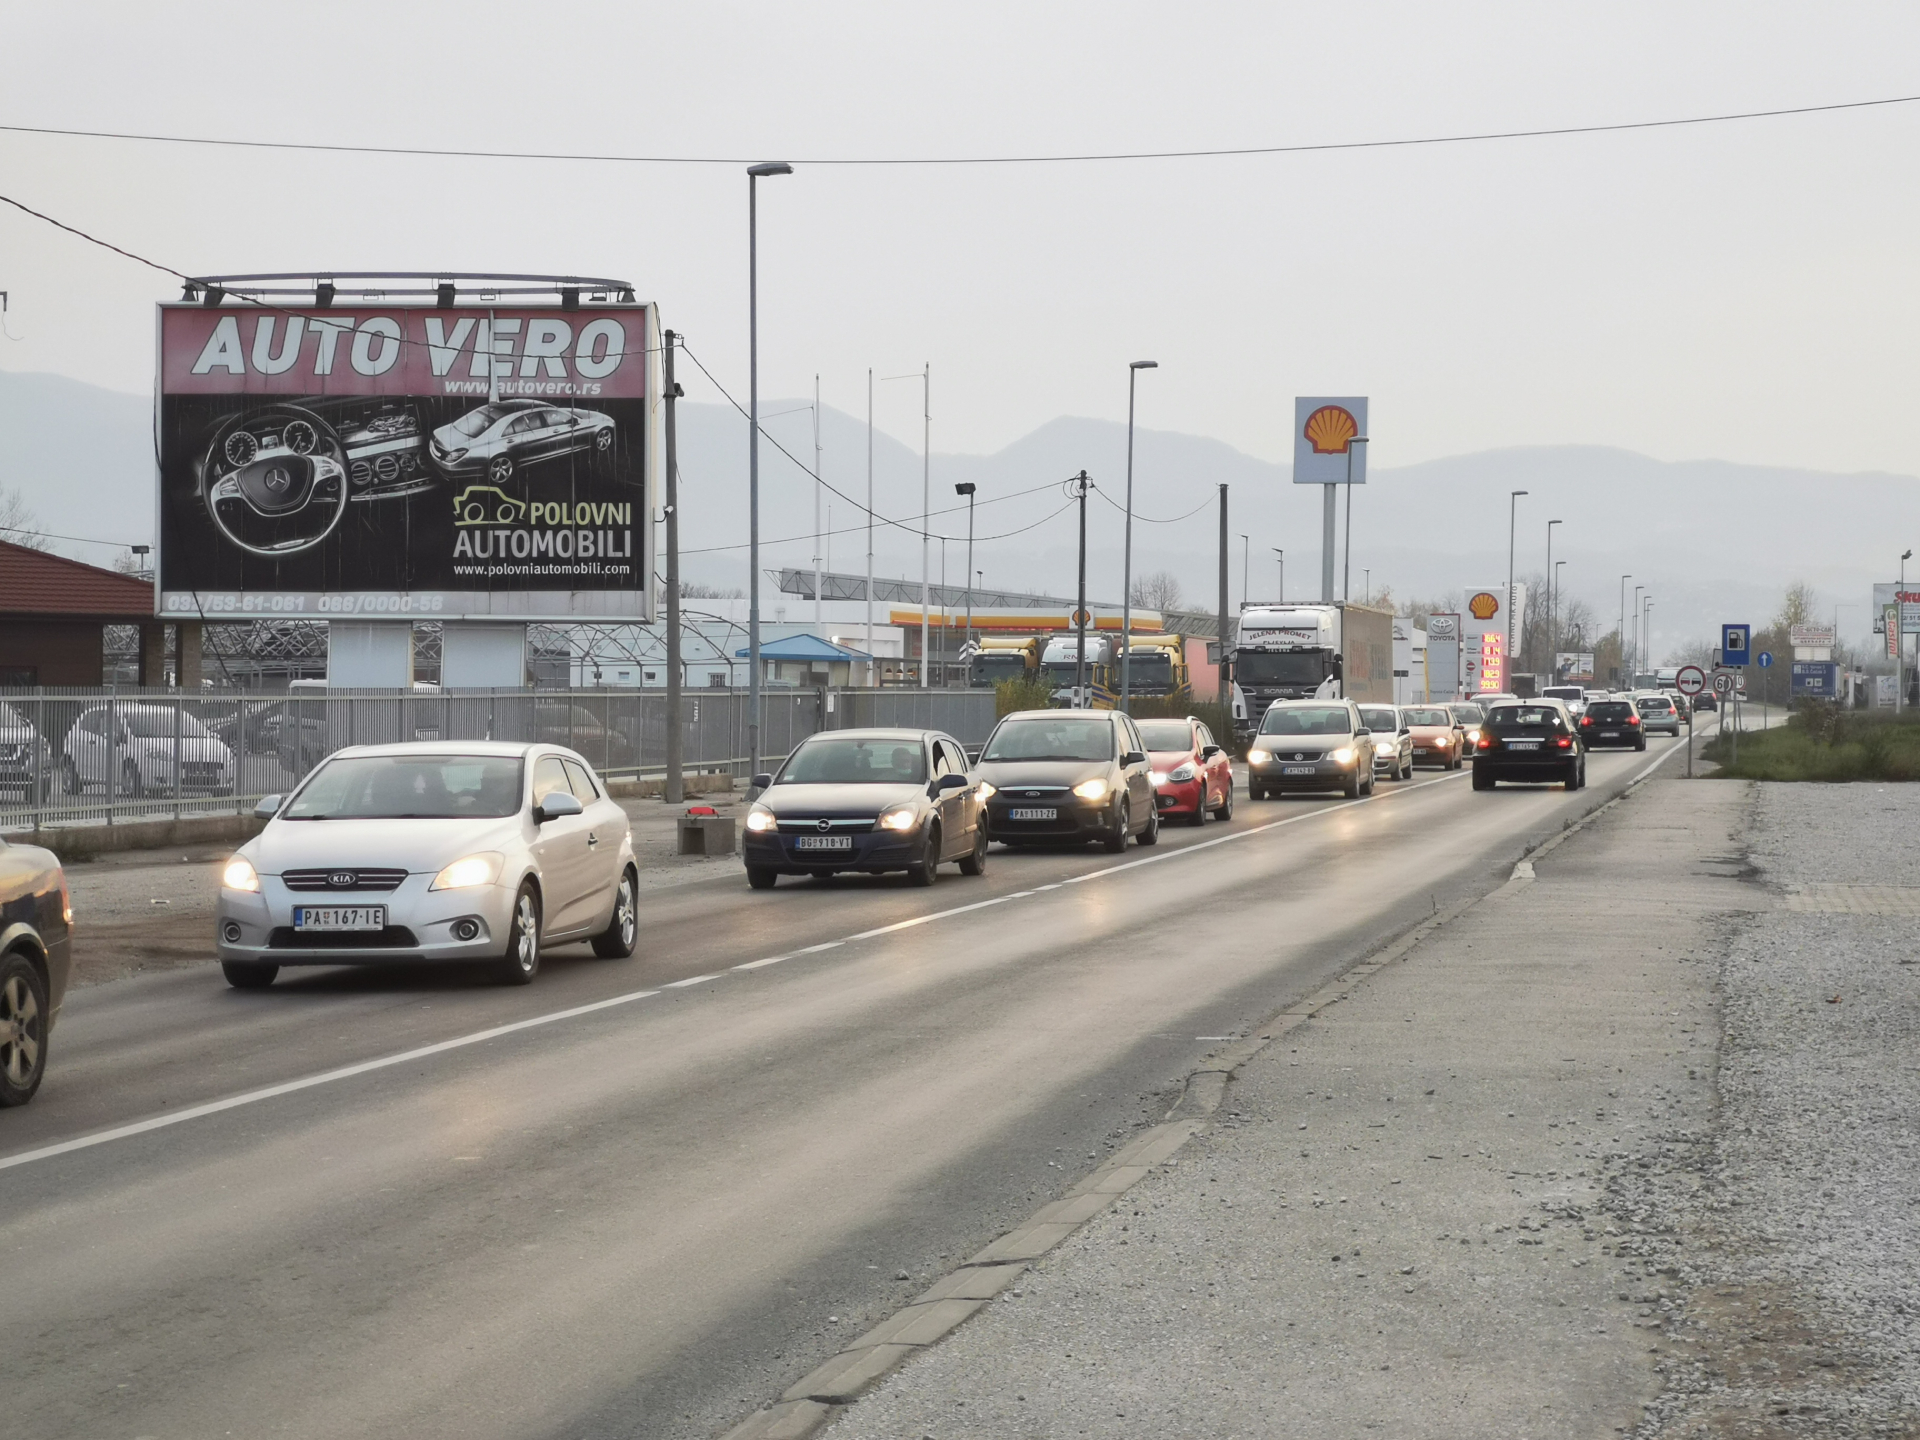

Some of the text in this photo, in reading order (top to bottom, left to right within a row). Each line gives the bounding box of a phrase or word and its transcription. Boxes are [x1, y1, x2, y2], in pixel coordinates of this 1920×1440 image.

[190, 315, 627, 380] AUTO VERO
[445, 380, 602, 396] wwwautovero.rs
[530, 501, 631, 526] POLOVNI
[452, 529, 631, 559] AUTOMOBILI
[453, 562, 630, 578] www.polovniautomobili.com
[1249, 630, 1312, 641] JELENA PROMET
[1887, 621, 1899, 655] Castrol
[1014, 809, 1025, 818] PA
[801, 838, 812, 848] BG
[332, 875, 351, 883] KIA
[304, 910, 322, 925] PA
